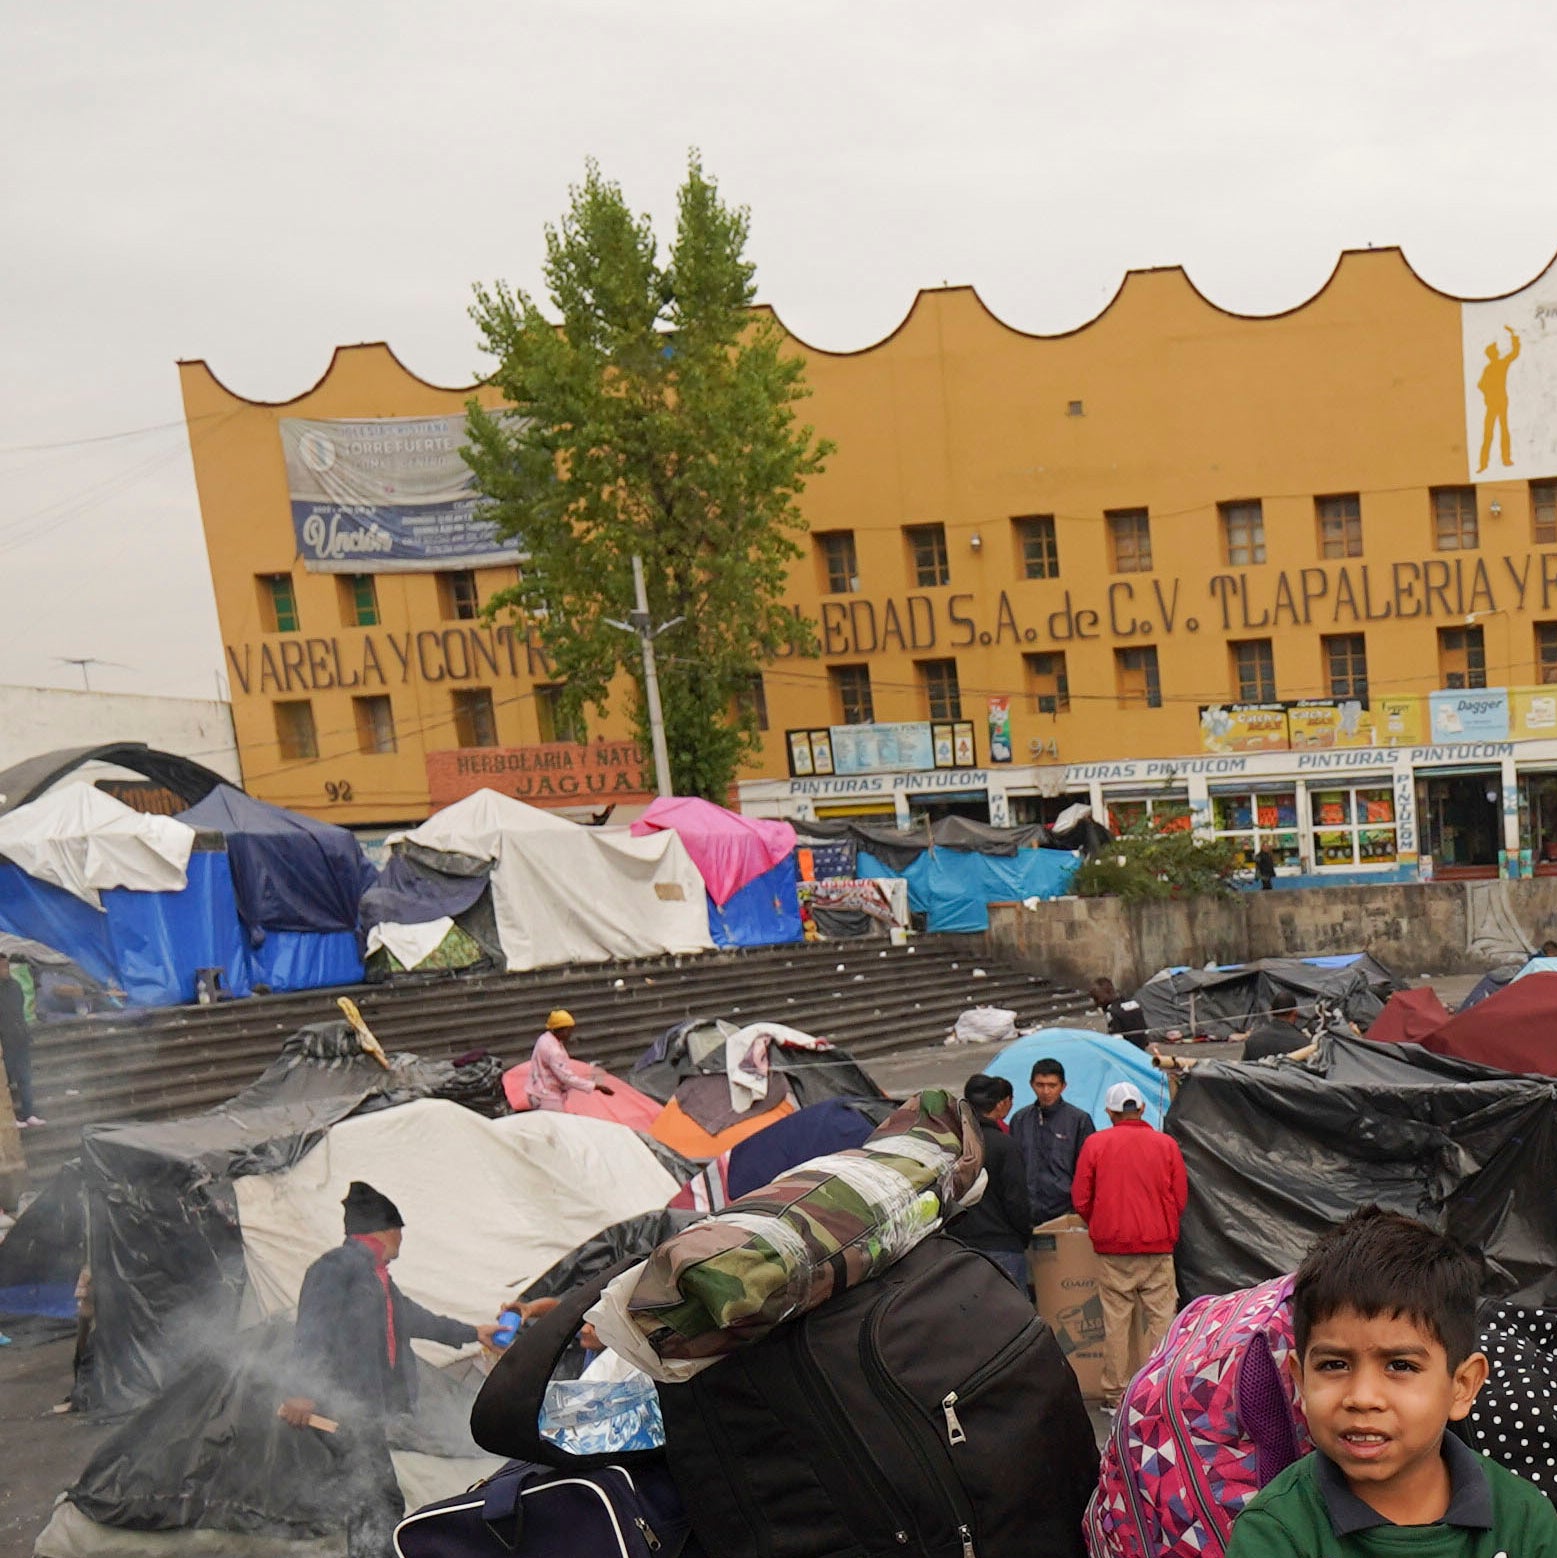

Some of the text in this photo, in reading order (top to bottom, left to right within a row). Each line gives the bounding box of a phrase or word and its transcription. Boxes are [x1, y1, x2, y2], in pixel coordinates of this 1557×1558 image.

[227, 632, 387, 695] VARELA
[387, 631, 411, 684] Y
[417, 625, 551, 683] CONTR
[1048, 589, 1100, 641] de
[1108, 577, 1200, 638] C.V.
[1209, 556, 1497, 630] TLAPALERIA
[1503, 553, 1531, 610] Y
[1457, 698, 1503, 715] Dagger
[1027, 737, 1058, 760] 94
[1297, 743, 1516, 769] PINTURAS PINTUCOM
[457, 750, 574, 776] HERBOLARIA
[596, 748, 645, 767] NATU
[1146, 758, 1248, 777] PINTUCOM
[324, 779, 354, 802] 92
[790, 771, 989, 795] PINTURAS PINTUCOM
[1396, 774, 1413, 849] PINTUCOM
